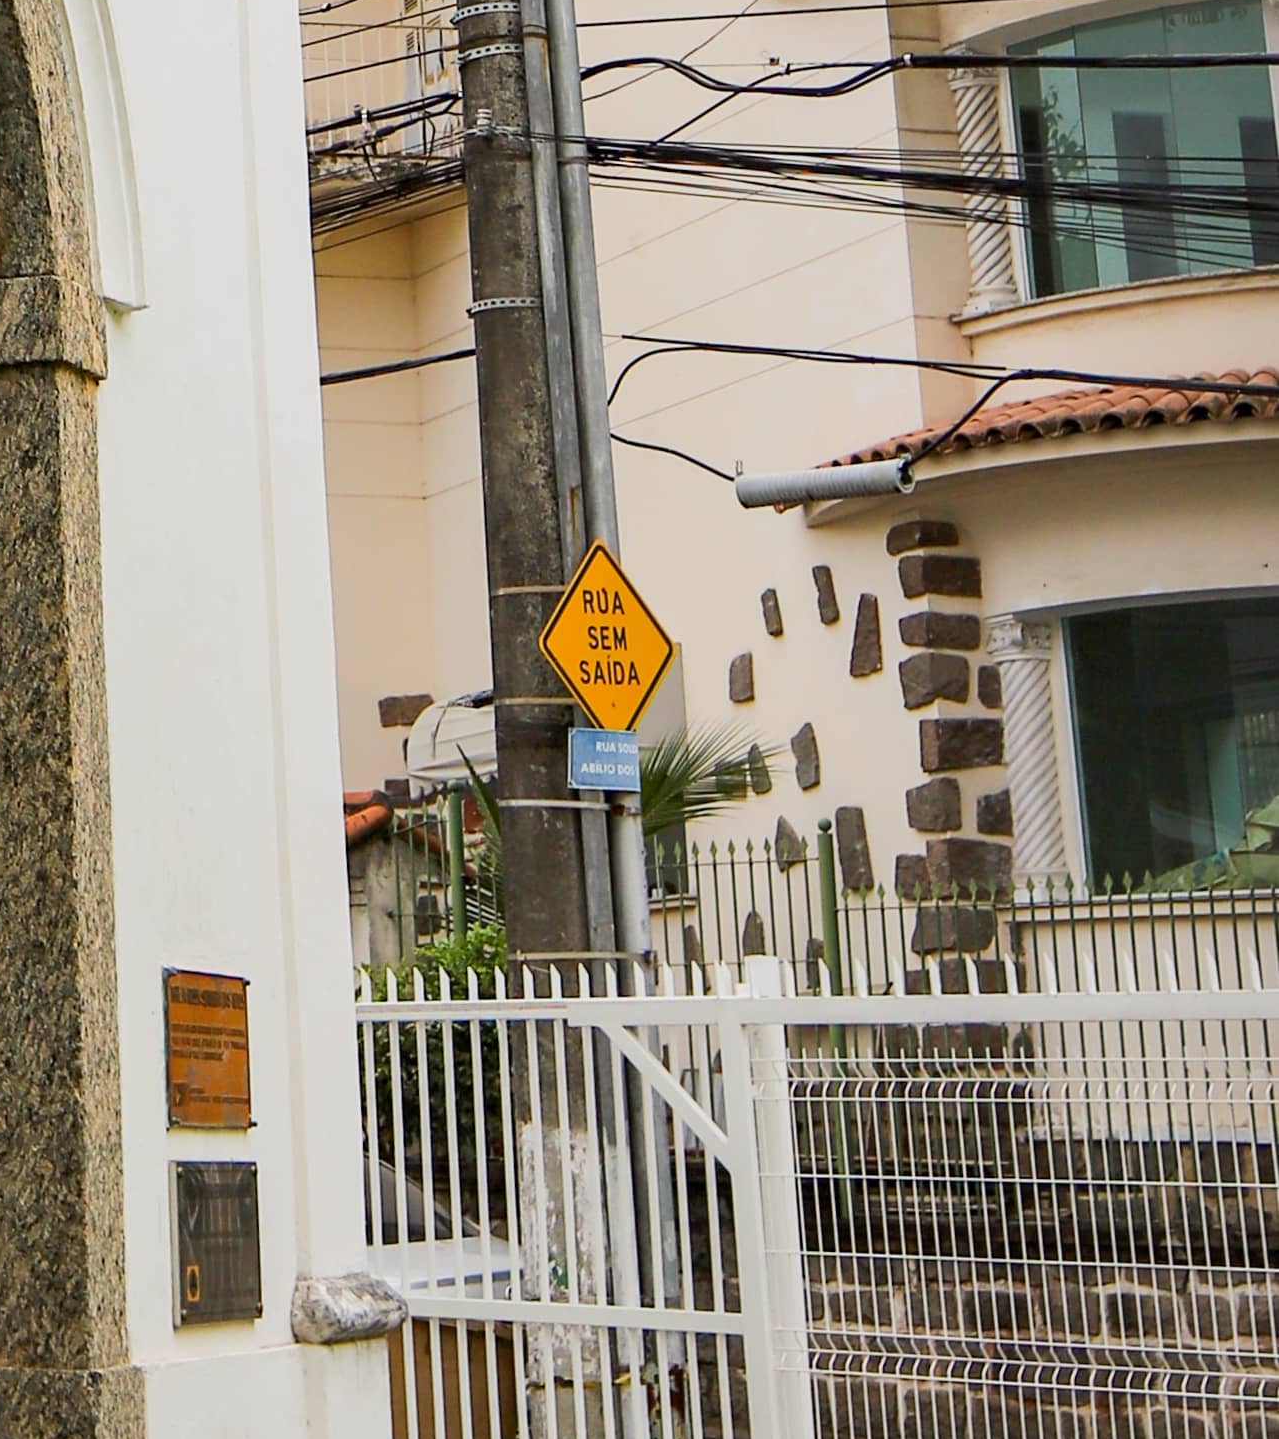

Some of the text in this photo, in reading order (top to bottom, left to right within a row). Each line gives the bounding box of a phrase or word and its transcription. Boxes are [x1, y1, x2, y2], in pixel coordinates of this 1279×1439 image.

[582, 589, 625, 615] RUA
[587, 625, 628, 651] SEM
[579, 654, 641, 685] SAÍDA
[595, 741, 617, 753] RUA
